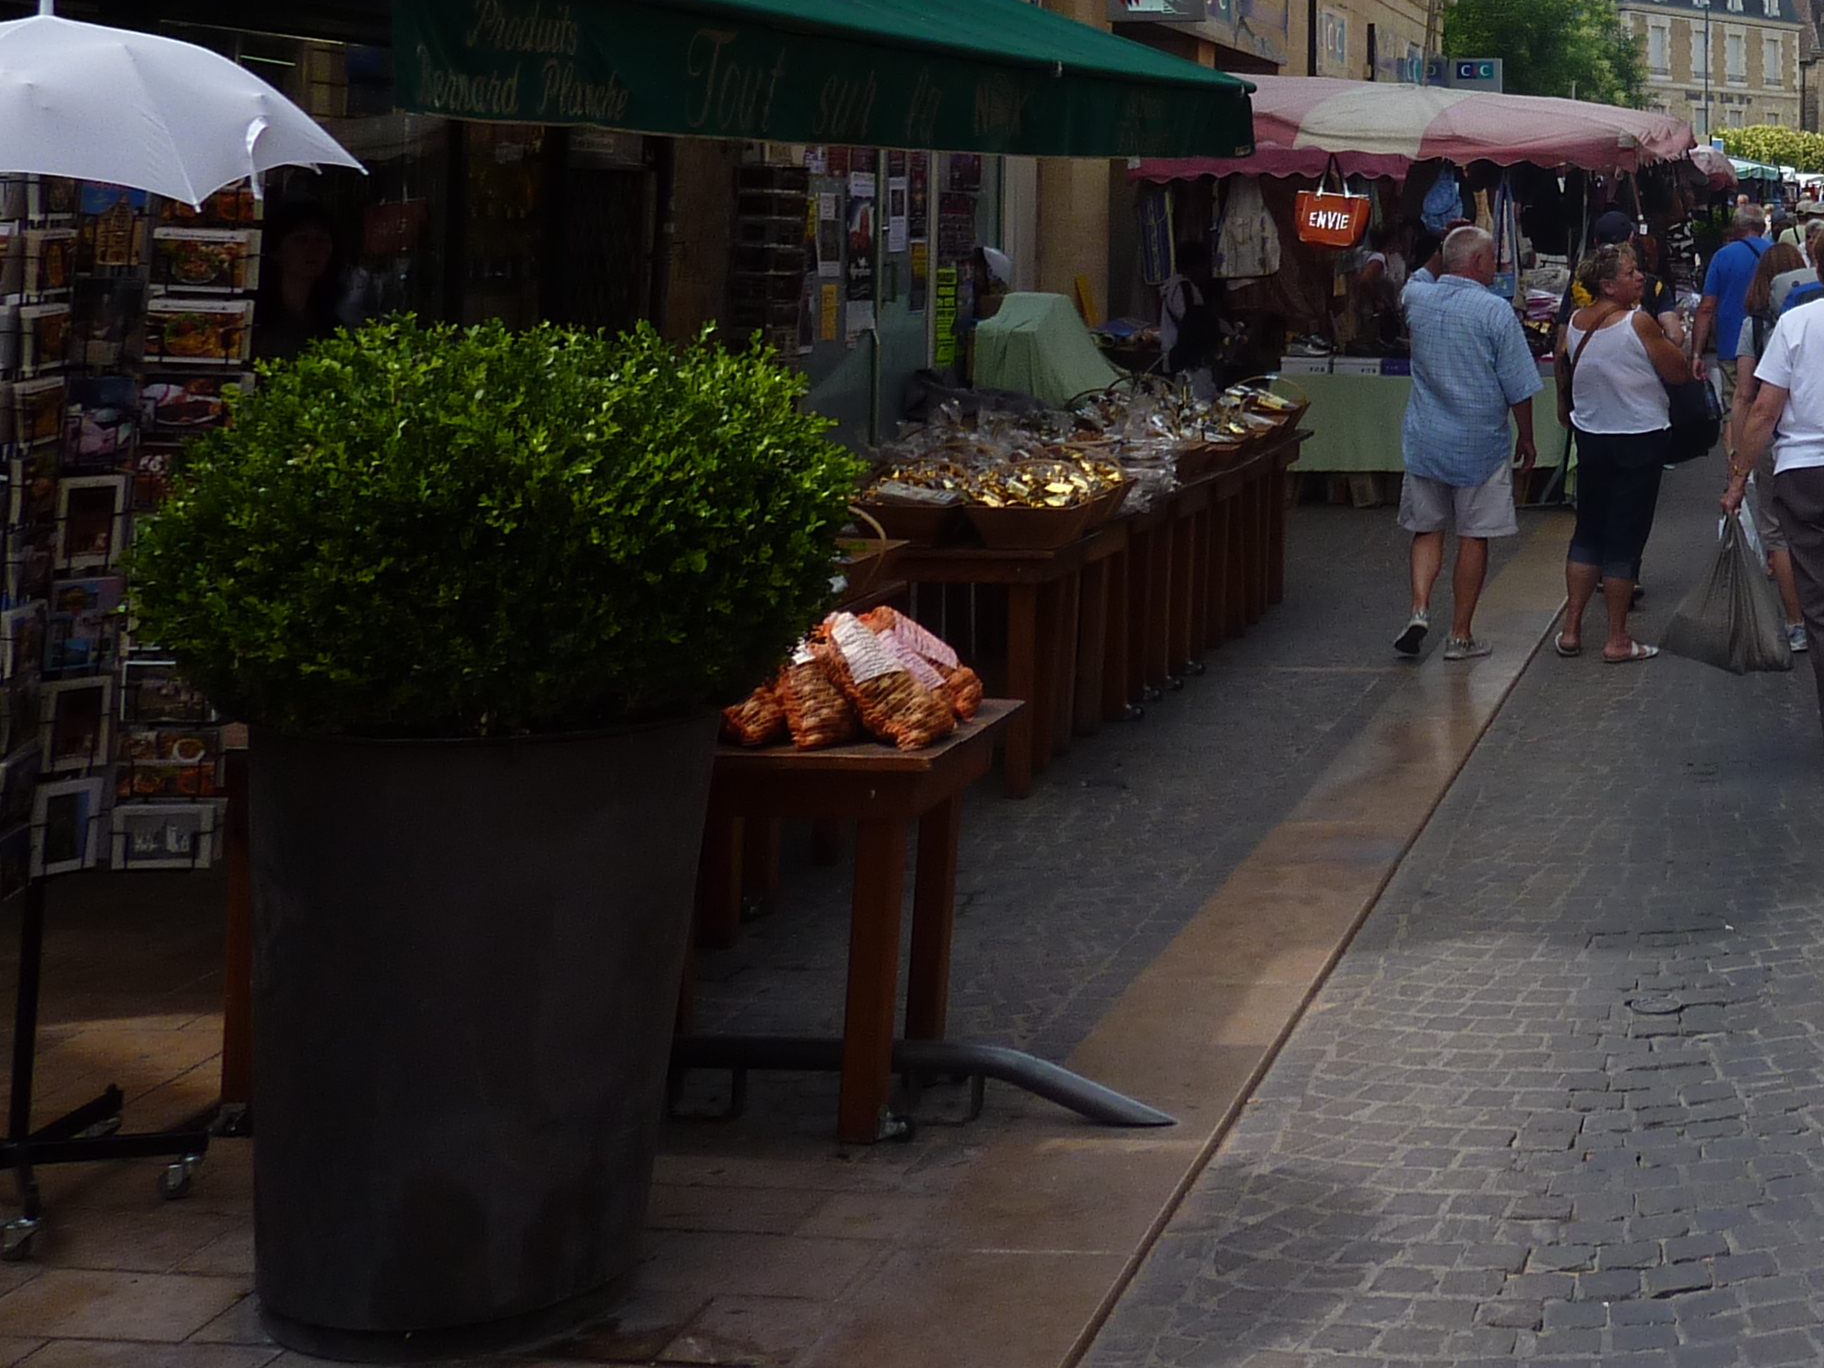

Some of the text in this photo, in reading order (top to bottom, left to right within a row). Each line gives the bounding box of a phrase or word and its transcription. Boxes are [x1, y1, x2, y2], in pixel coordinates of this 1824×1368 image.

[416, 42, 521, 116] Bernard
[1461, 64, 1489, 77] CIC
[1309, 211, 1350, 230] ENVIE
